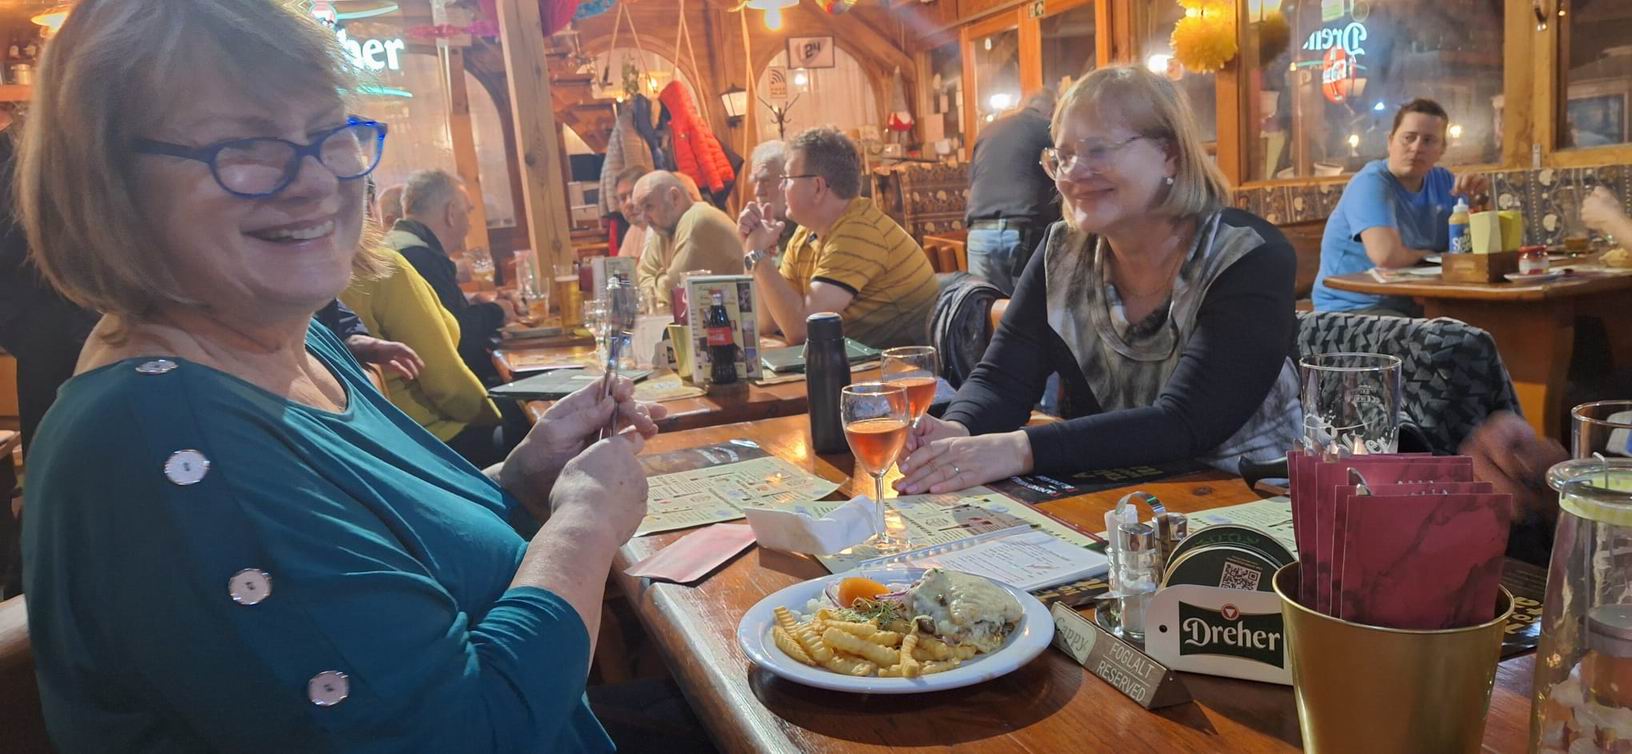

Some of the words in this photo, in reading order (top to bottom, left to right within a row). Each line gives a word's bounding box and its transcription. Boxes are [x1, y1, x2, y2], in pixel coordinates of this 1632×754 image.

[1183, 617, 1281, 651] Dreher
[1108, 642, 1155, 679] FOGLALT
[1096, 660, 1147, 702] RESERVED
